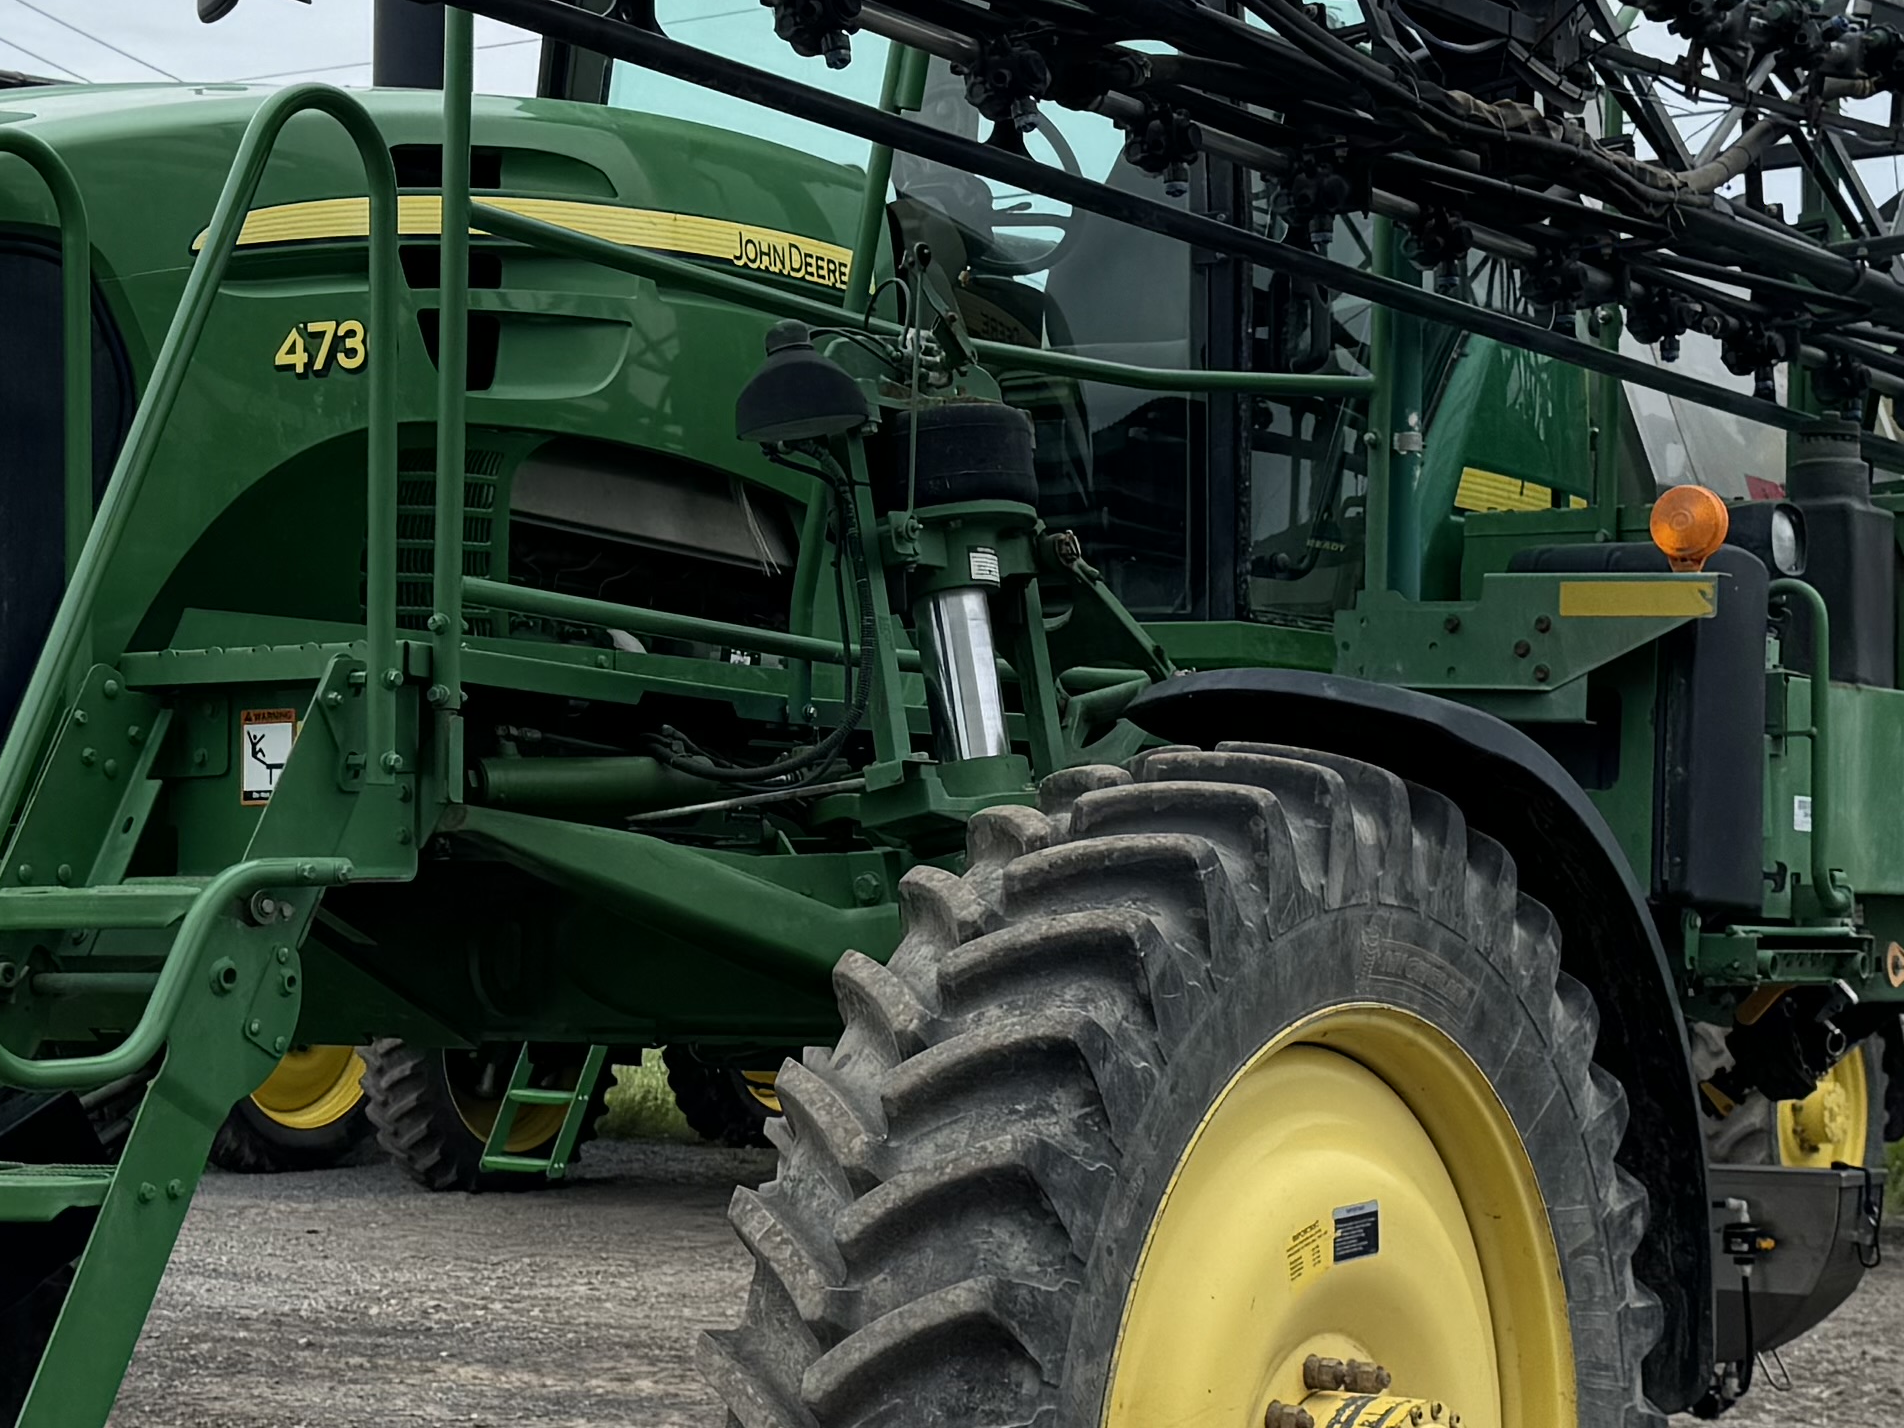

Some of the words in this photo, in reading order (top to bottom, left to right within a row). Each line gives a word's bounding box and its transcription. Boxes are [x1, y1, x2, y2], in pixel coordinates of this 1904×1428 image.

[733, 230, 786, 271] JOHN
[788, 242, 848, 285] DEERE
[274, 319, 371, 378] 473
